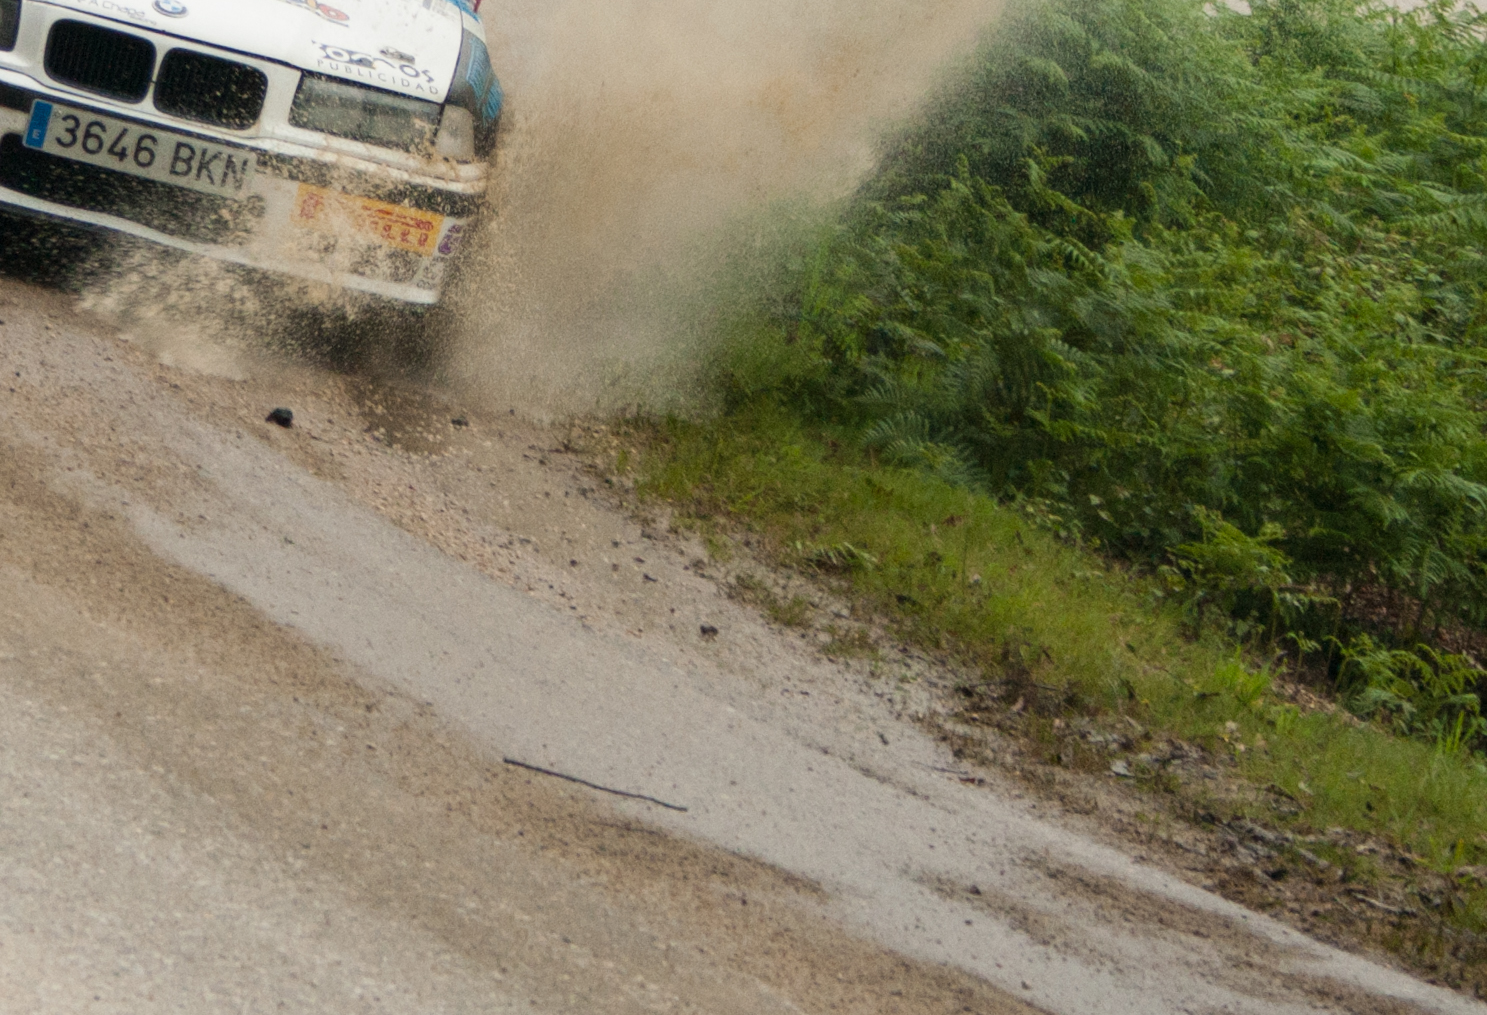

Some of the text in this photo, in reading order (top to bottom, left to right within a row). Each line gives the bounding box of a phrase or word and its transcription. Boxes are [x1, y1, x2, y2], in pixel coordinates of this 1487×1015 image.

[316, 58, 440, 96] PUBLICIDAD
[31, 128, 41, 140] E
[55, 114, 248, 190] 3646 BKN
